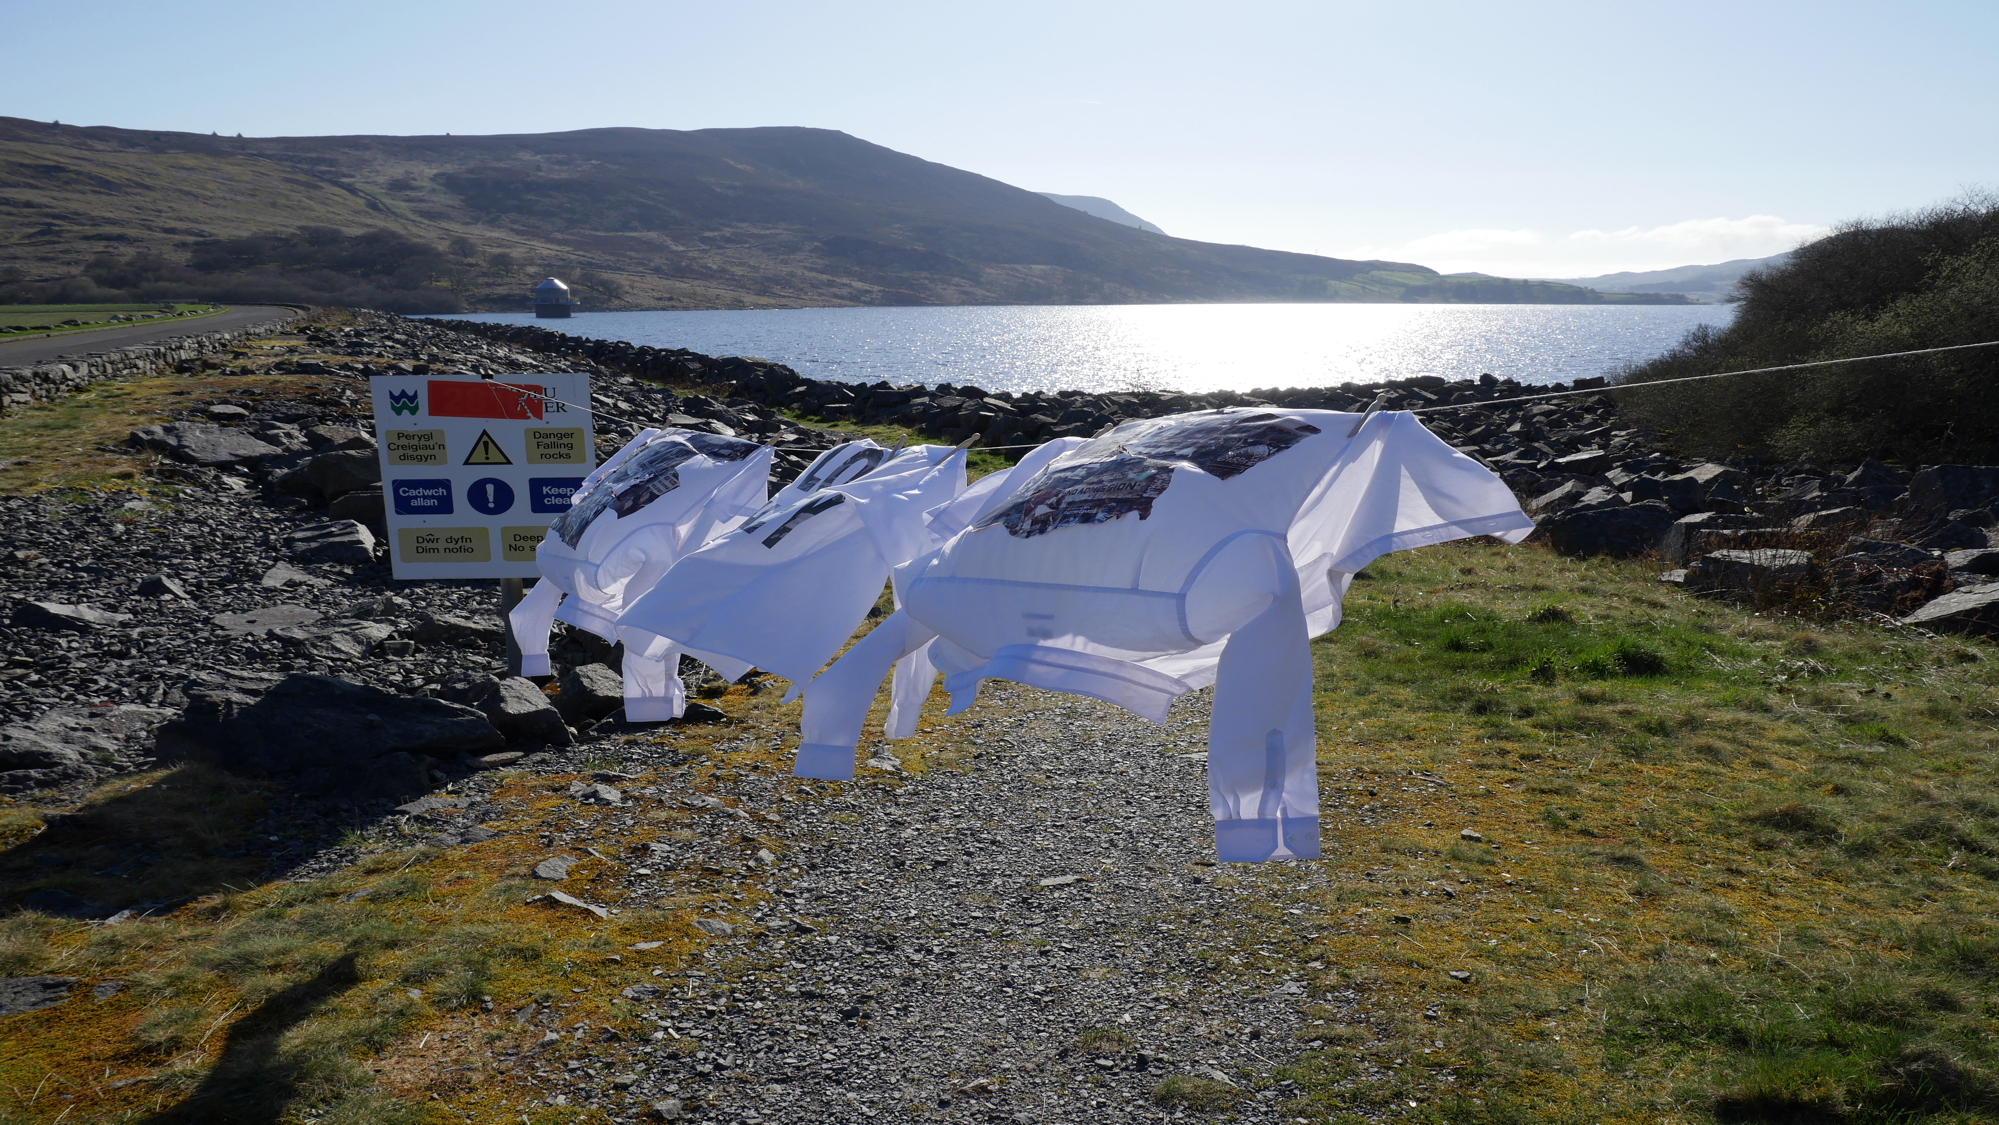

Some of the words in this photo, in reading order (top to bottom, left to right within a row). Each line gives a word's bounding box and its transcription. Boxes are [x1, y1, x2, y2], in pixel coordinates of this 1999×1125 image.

[397, 432, 434, 442] Perygl
[533, 431, 575, 441] Danger
[388, 441, 447, 453] Creigiau'n
[536, 441, 574, 451] Falling
[398, 453, 437, 463] disgyn
[540, 451, 572, 460] rocks
[399, 487, 447, 497] Cadwch
[542, 486, 576, 496] Keep
[410, 497, 438, 506] allan
[544, 496, 571, 505] clea
[416, 532, 440, 544] Dŵr
[445, 535, 473, 546] dyfn
[514, 533, 544, 544] Deep
[416, 546, 440, 554] Dim
[444, 546, 475, 554] nofio
[509, 544, 525, 552] No
